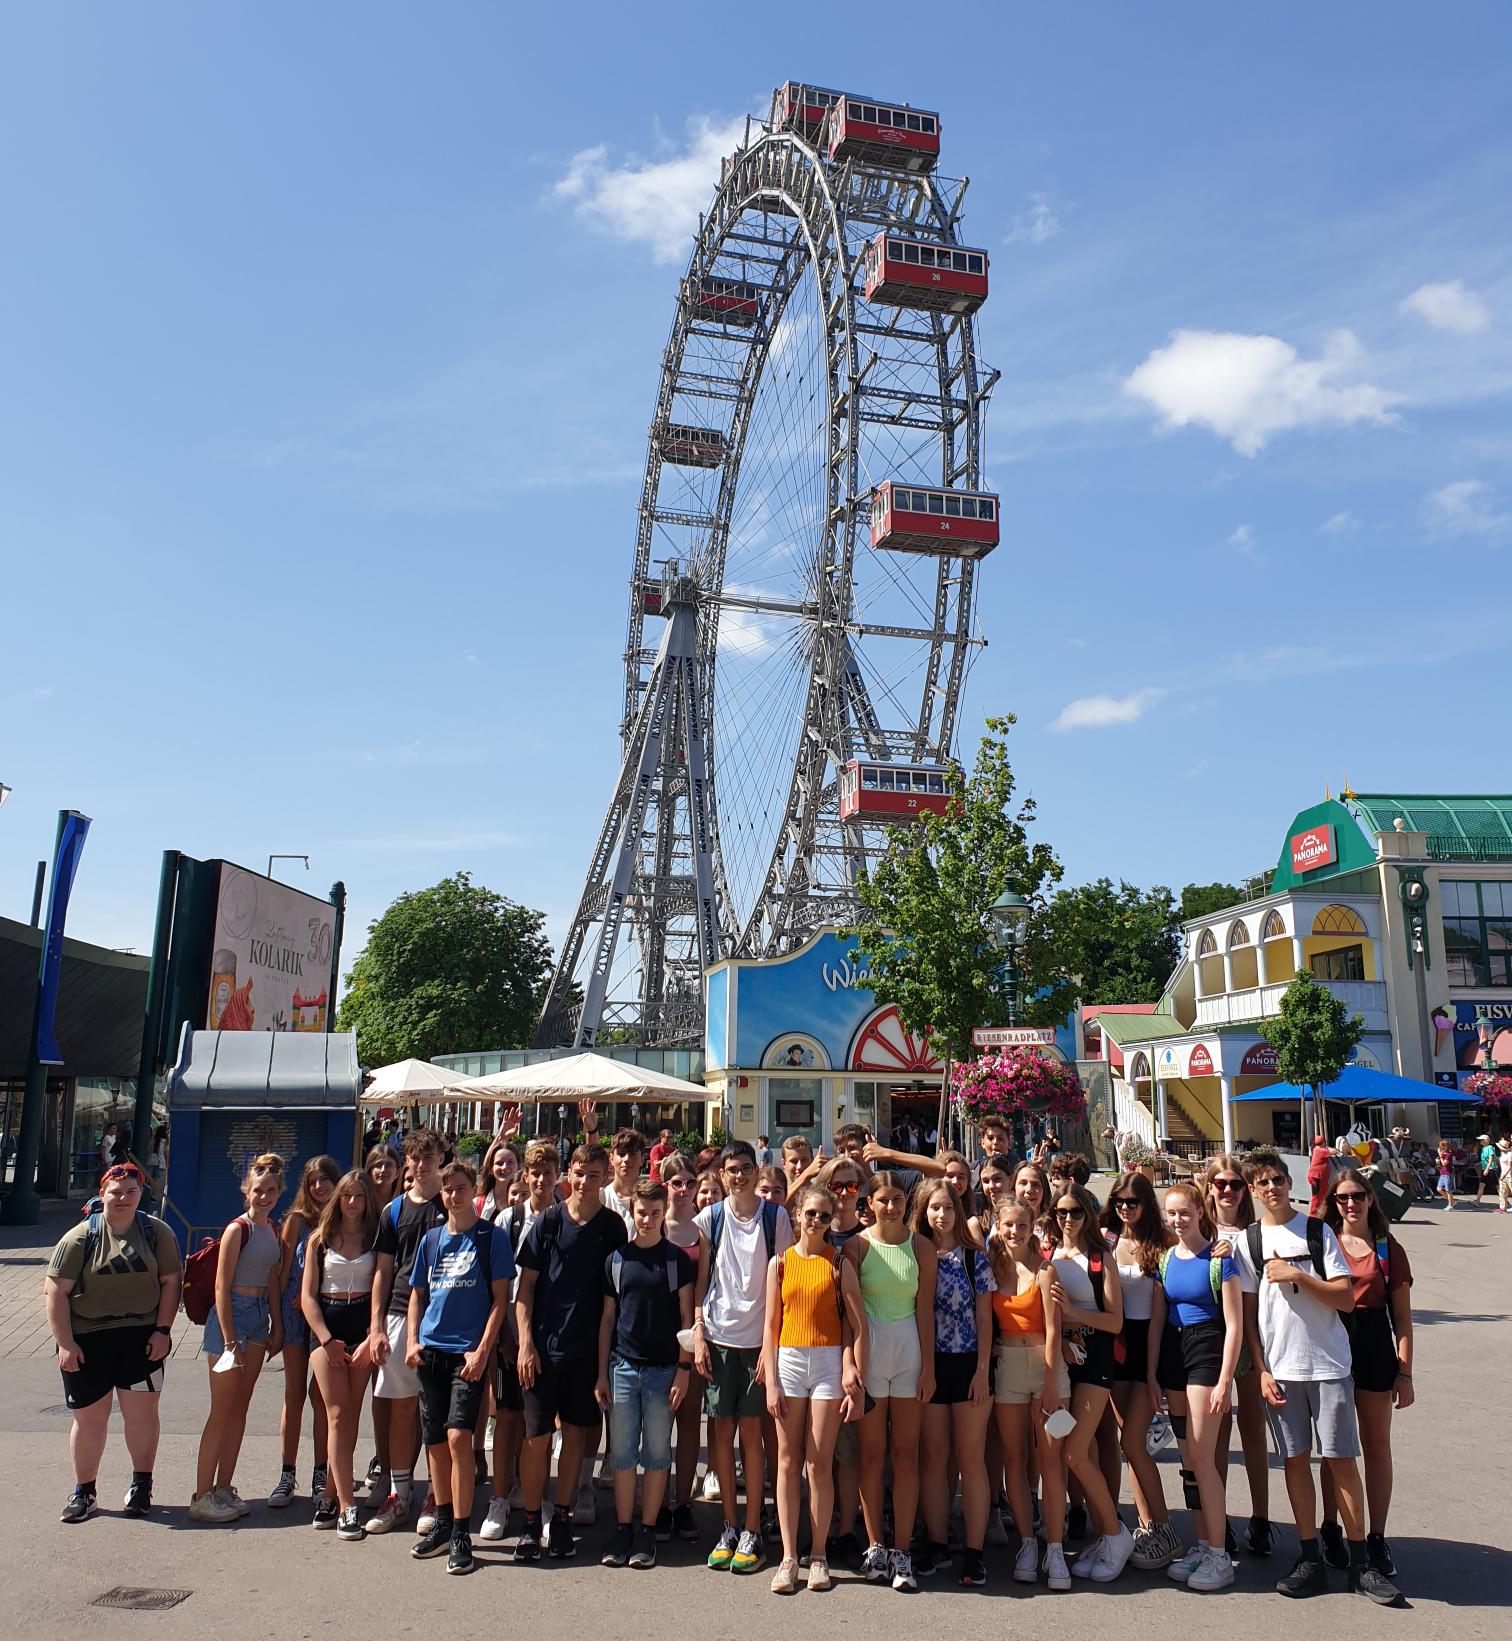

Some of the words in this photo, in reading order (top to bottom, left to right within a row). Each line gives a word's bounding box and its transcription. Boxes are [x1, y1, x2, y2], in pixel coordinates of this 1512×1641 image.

[940, 522, 950, 530] 24
[907, 799, 917, 807] 22
[1293, 842, 1328, 863] PANORAMA
[249, 938, 304, 977] KOLARIK
[976, 1032, 1052, 1043] RIESENRADPLATZ
[1246, 1057, 1281, 1065] PANORA
